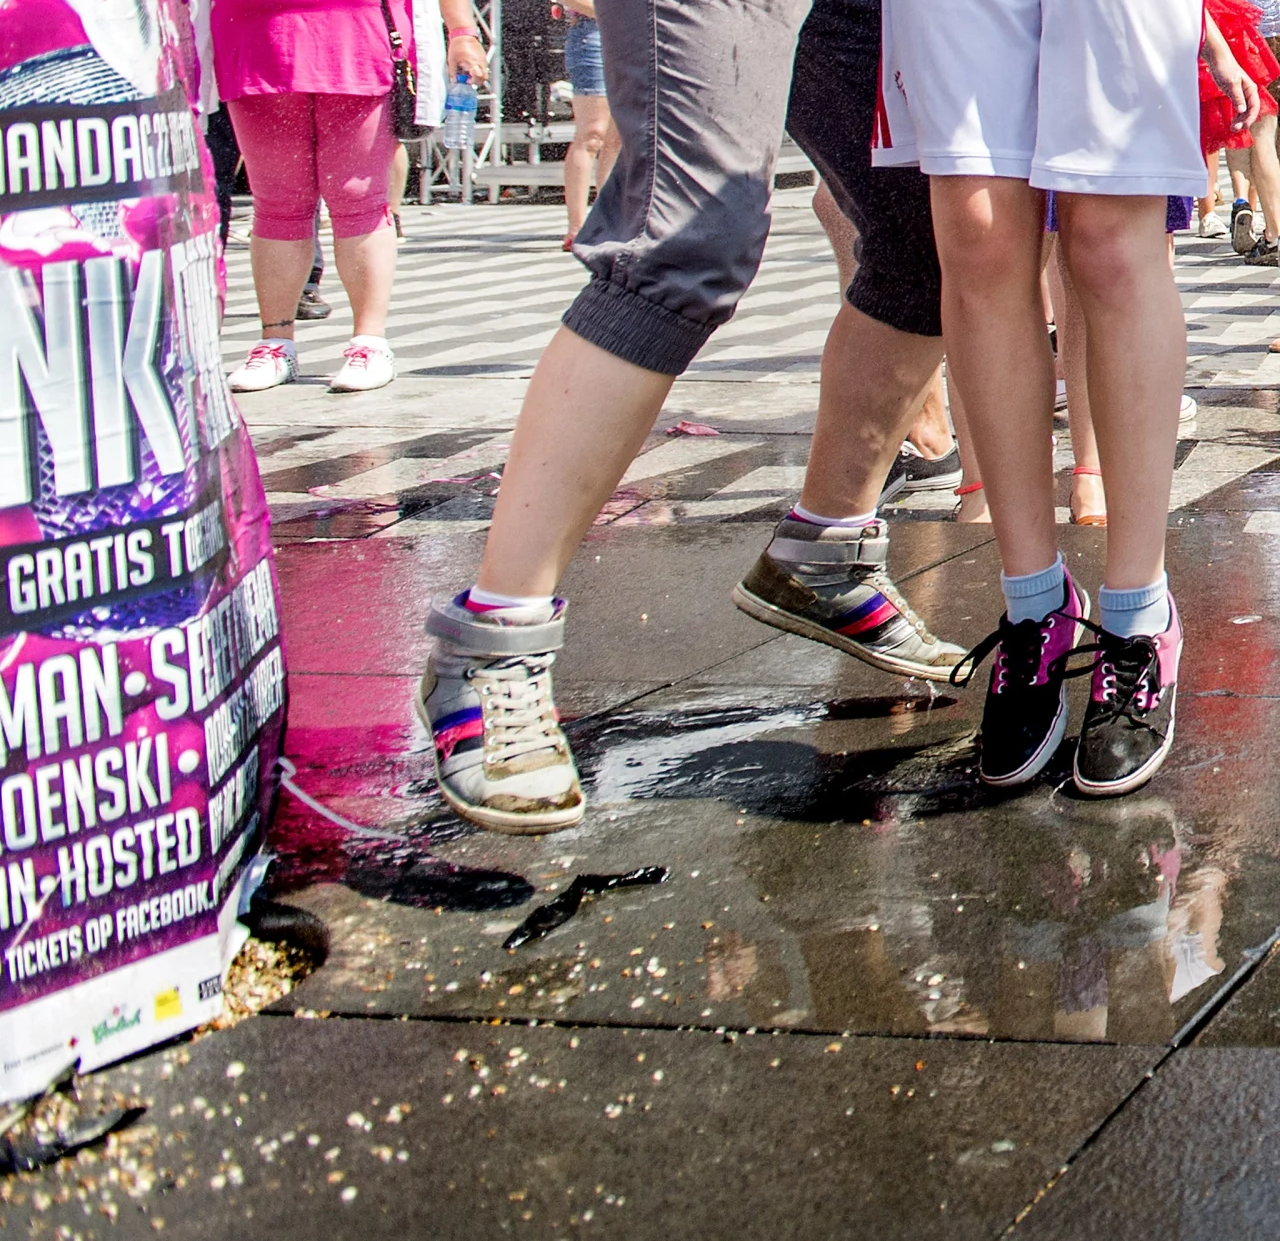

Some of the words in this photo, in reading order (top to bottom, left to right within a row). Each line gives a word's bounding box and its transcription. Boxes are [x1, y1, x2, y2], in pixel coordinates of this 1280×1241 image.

[0, 113, 156, 195] ANDAG
[9, 530, 154, 615] GRATIS
[0, 729, 171, 855] OENSKI
[57, 806, 200, 908] HOSTED
[5, 925, 84, 983] TICKETS
[85, 913, 114, 954] OP
[116, 873, 221, 943] FACEBOOK.
